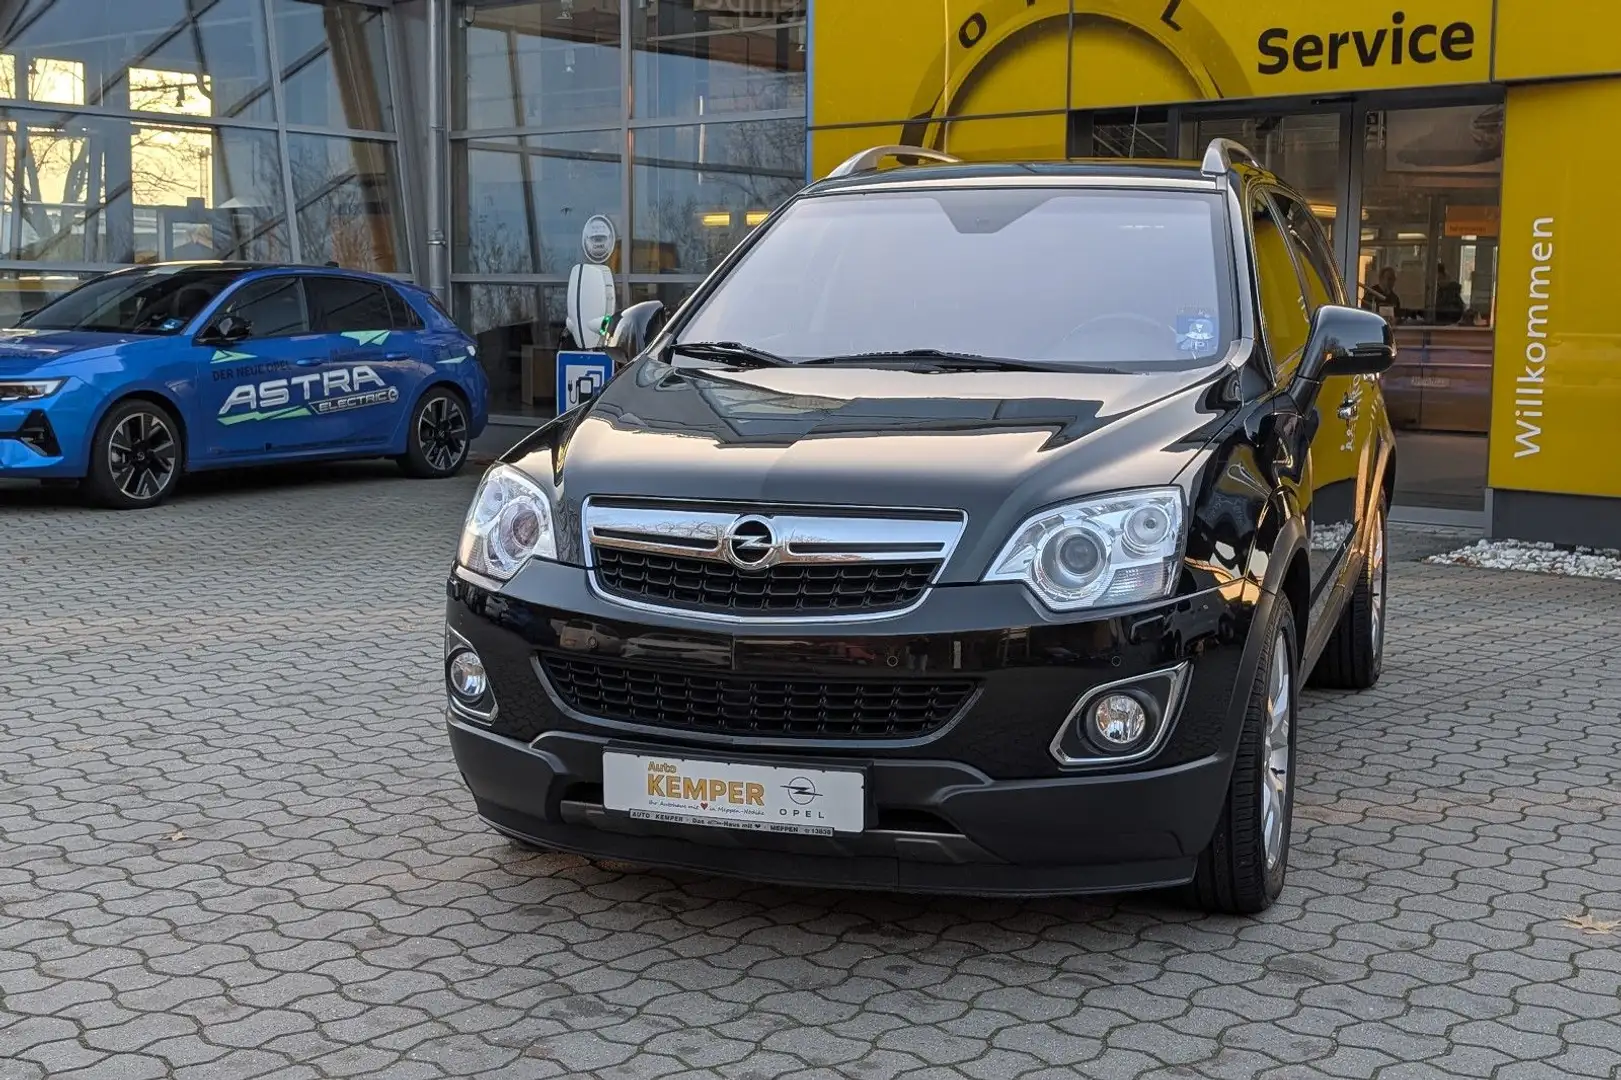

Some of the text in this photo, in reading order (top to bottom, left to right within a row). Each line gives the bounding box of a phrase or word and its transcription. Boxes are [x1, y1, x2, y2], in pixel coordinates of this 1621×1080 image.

[1257, 12, 1475, 75] Service
[1513, 216, 1554, 459] Willkommen
[212, 368, 234, 381] DER
[237, 364, 265, 378] NEUE
[218, 365, 386, 415] ASTRA
[318, 391, 388, 412] ELECTRIC
[648, 761, 677, 774] Auto
[647, 773, 766, 807] KEMPER
[632, 811, 650, 819] AUTO
[655, 814, 683, 822] KEMPER
[770, 825, 799, 833] MEPPEN
[779, 809, 825, 819] OPEL
